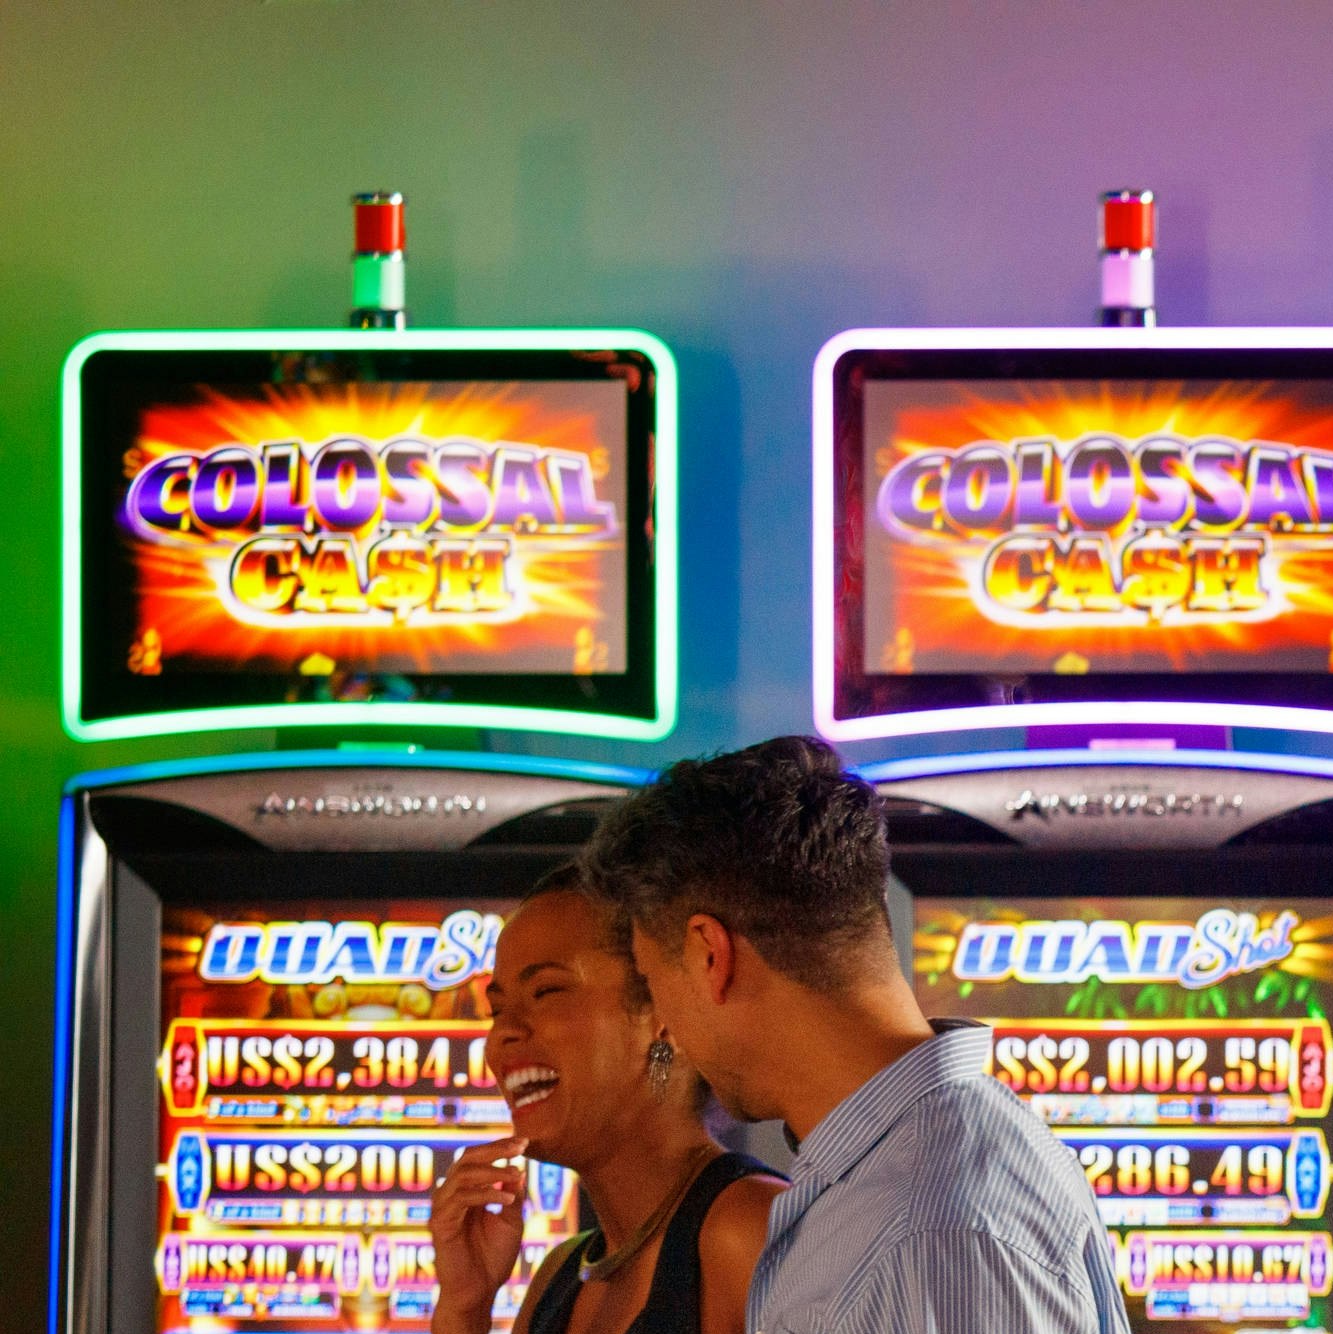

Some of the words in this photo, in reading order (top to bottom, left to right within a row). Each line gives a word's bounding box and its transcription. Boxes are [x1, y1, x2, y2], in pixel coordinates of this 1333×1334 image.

[125, 438, 617, 540] COLOSSAL
[423, 910, 504, 990] Sh
[207, 1033, 497, 1090] US$2,384.0
[992, 1034, 1291, 1093] S$2,002.59
[215, 1142, 466, 1193] US$200.
[1076, 1144, 1283, 1195] 286.49
